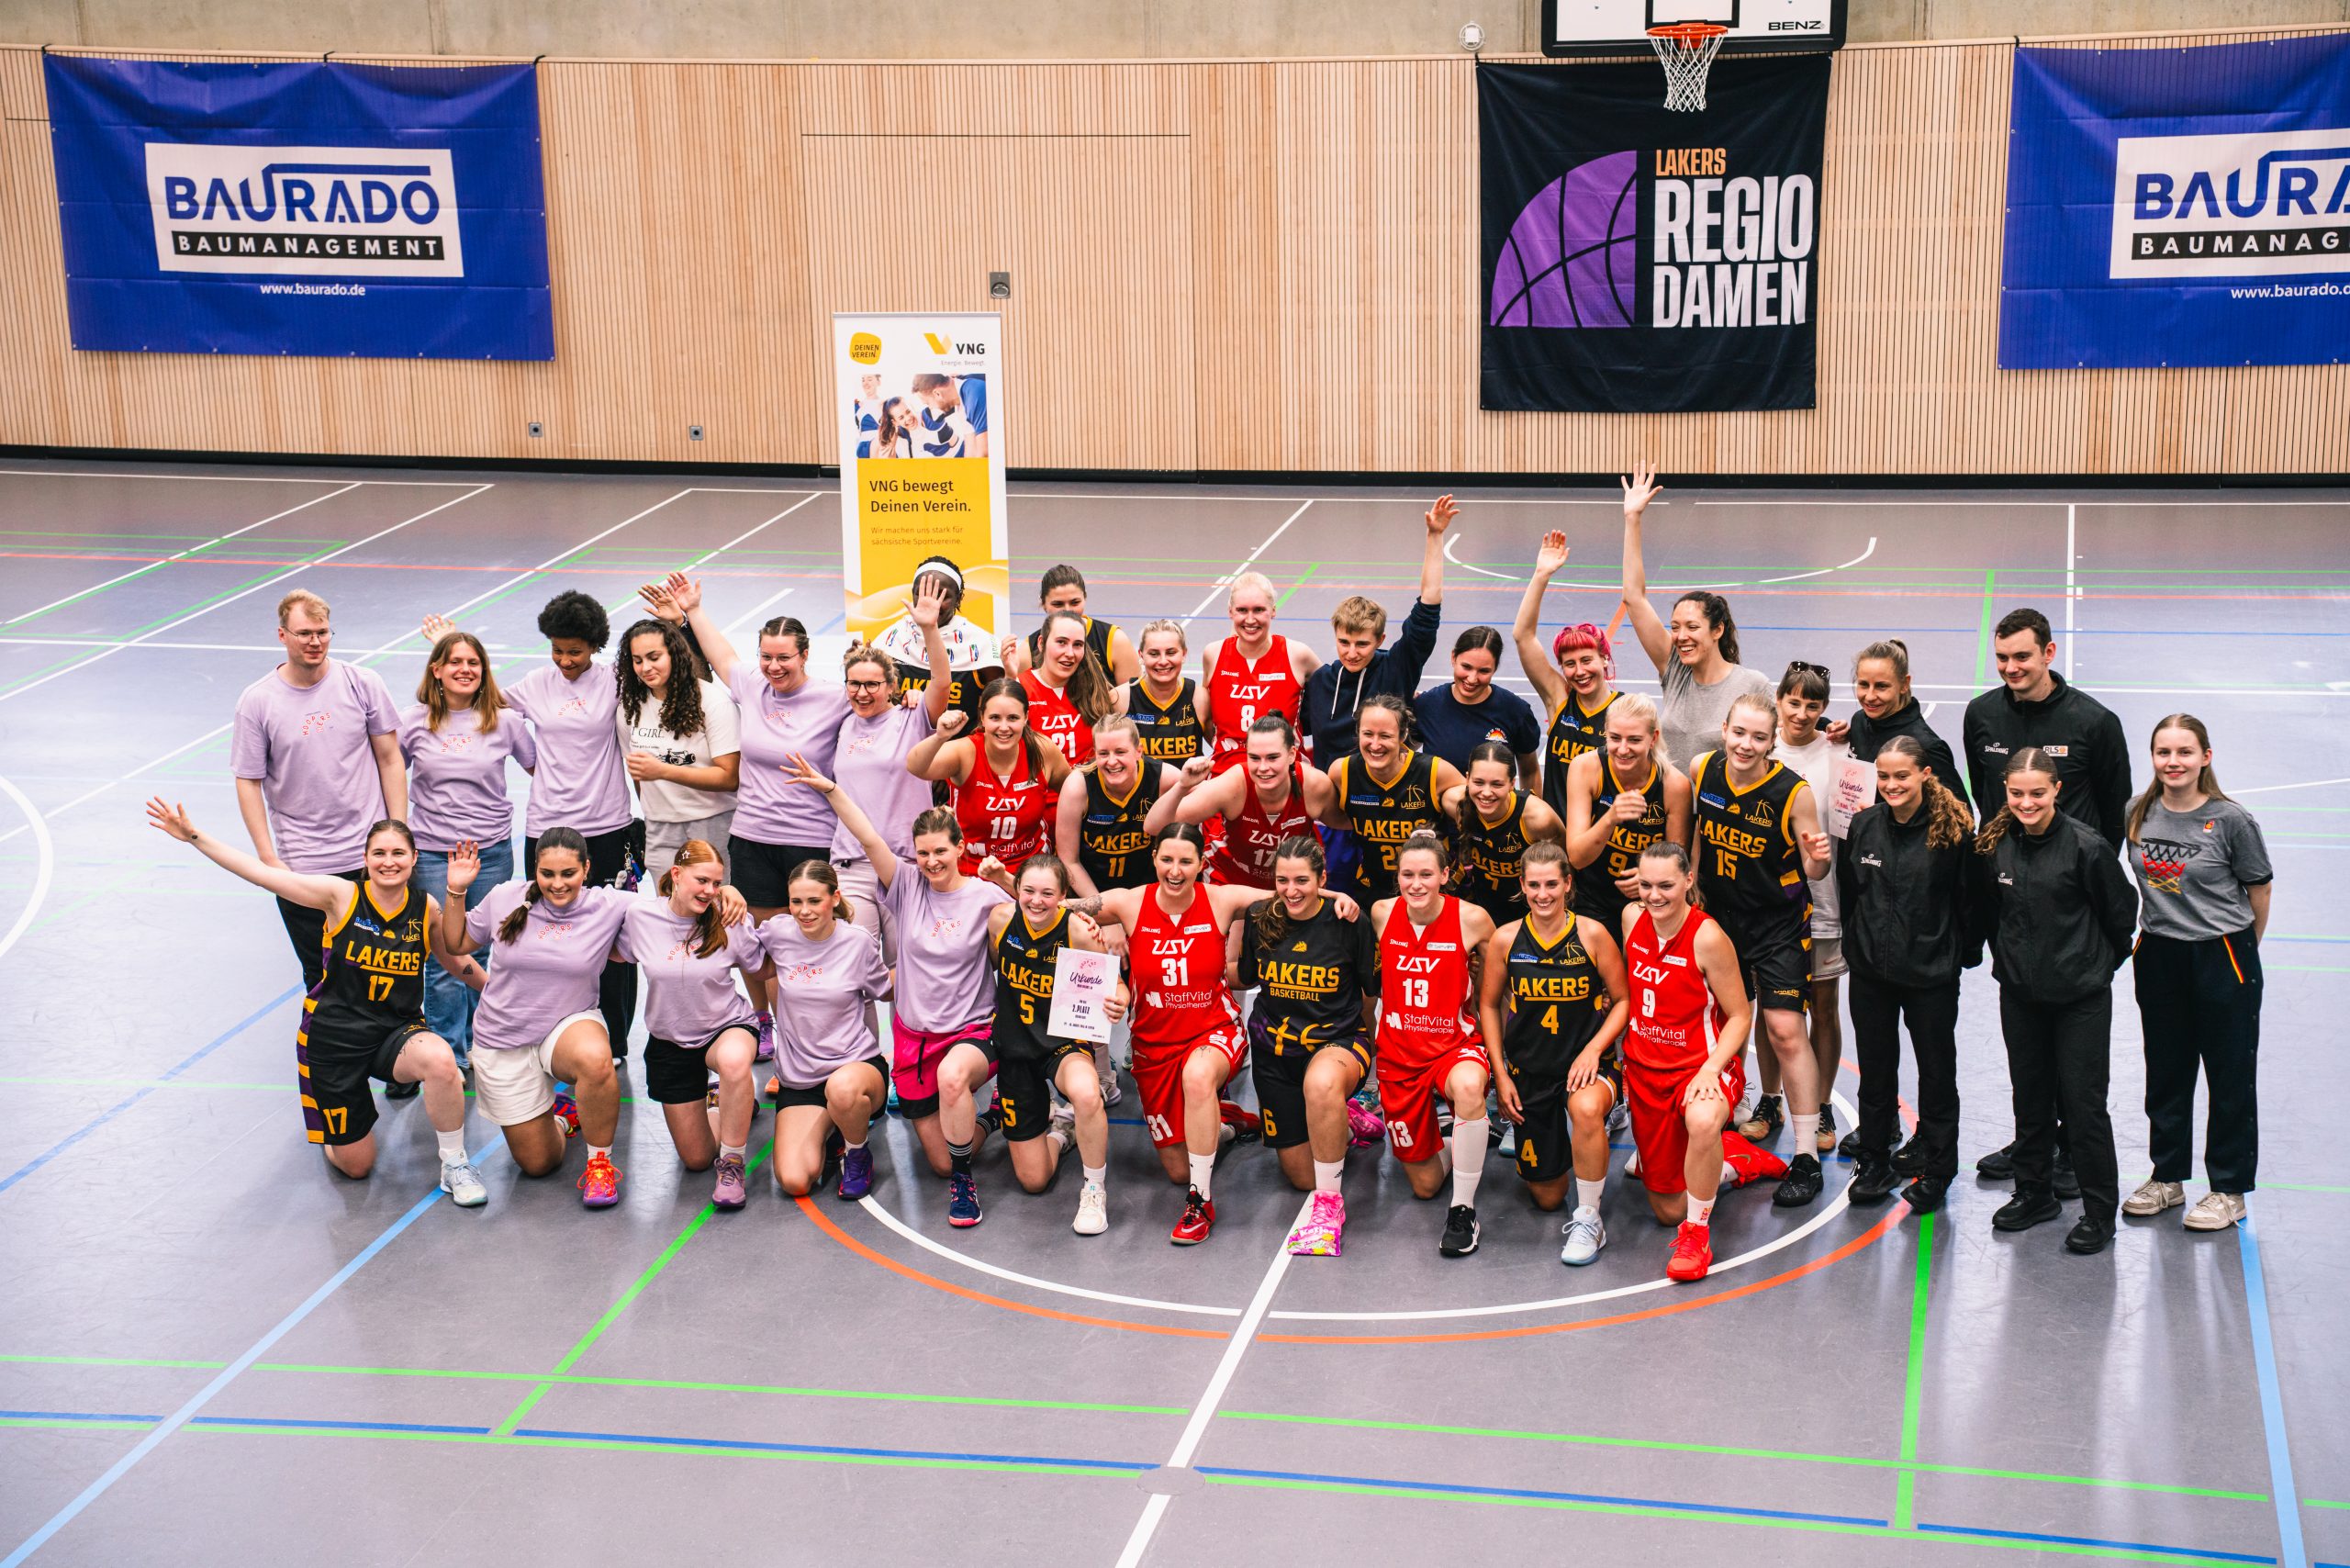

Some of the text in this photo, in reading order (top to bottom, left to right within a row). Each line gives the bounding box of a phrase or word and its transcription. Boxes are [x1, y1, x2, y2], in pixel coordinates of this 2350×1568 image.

[1768, 21, 1821, 30] BENZ
[1655, 148, 1727, 176] LAKERS
[164, 163, 440, 225] BAURADO
[1654, 174, 1814, 263] REGIO
[178, 235, 439, 258] BAUMANAGEMENT
[260, 283, 366, 297] www.baurado.de
[1653, 262, 1807, 328] DAMEN
[956, 343, 985, 355] VNG
[869, 479, 954, 495] VNG bewegt
[870, 499, 971, 512] Deinen Verein.
[932, 526, 950, 534] stark
[952, 526, 964, 534] für
[871, 537, 963, 547] sächsische Sportvereine.
[1230, 685, 1270, 700] USV
[1042, 713, 1081, 731] USV
[1241, 705, 1255, 733] 8
[1052, 732, 1076, 758] 21
[1140, 735, 1197, 756] AKERS
[1985, 745, 2009, 755] SPALDING
[986, 796, 1026, 812] USV
[990, 816, 1017, 840] 10
[1745, 813, 1774, 826] LAKERS
[1083, 831, 1151, 854] LAKERS
[1109, 857, 1125, 878] 11
[1254, 848, 1277, 867] 17
[1607, 853, 1628, 878] 9
[1717, 850, 1738, 880] 15
[1141, 926, 1161, 935] SPALDING
[1151, 938, 1195, 955] USV
[1389, 938, 1409, 947] SPALDING
[345, 941, 420, 973] LAKERS
[1396, 955, 1440, 973] USV
[1560, 956, 1586, 965] LAKERS
[1002, 957, 1055, 997] LAKER
[1069, 972, 1103, 985] Urkunde
[1161, 958, 1189, 987] 31
[1257, 958, 1339, 989] LAKERS
[1632, 960, 1670, 985] USV
[368, 975, 395, 1002] 17
[1164, 990, 1213, 1002] StaffVital
[1270, 987, 1320, 1002] BASKETBALL
[1403, 978, 1429, 1008] 13
[1511, 976, 1590, 998] LAKERS
[1020, 994, 1035, 1025] 5
[1642, 988, 1656, 1018] 9
[1404, 1014, 1454, 1026] StaffVital
[1404, 1024, 1455, 1035] Physiotherapie
[1540, 1005, 1559, 1035] 4
[323, 1107, 348, 1135] 17
[1002, 1098, 1017, 1127] 5
[1263, 1108, 1278, 1137] 6
[1147, 1114, 1174, 1141] 31
[1386, 1120, 1414, 1148] 13
[1520, 1138, 1538, 1167] 4
